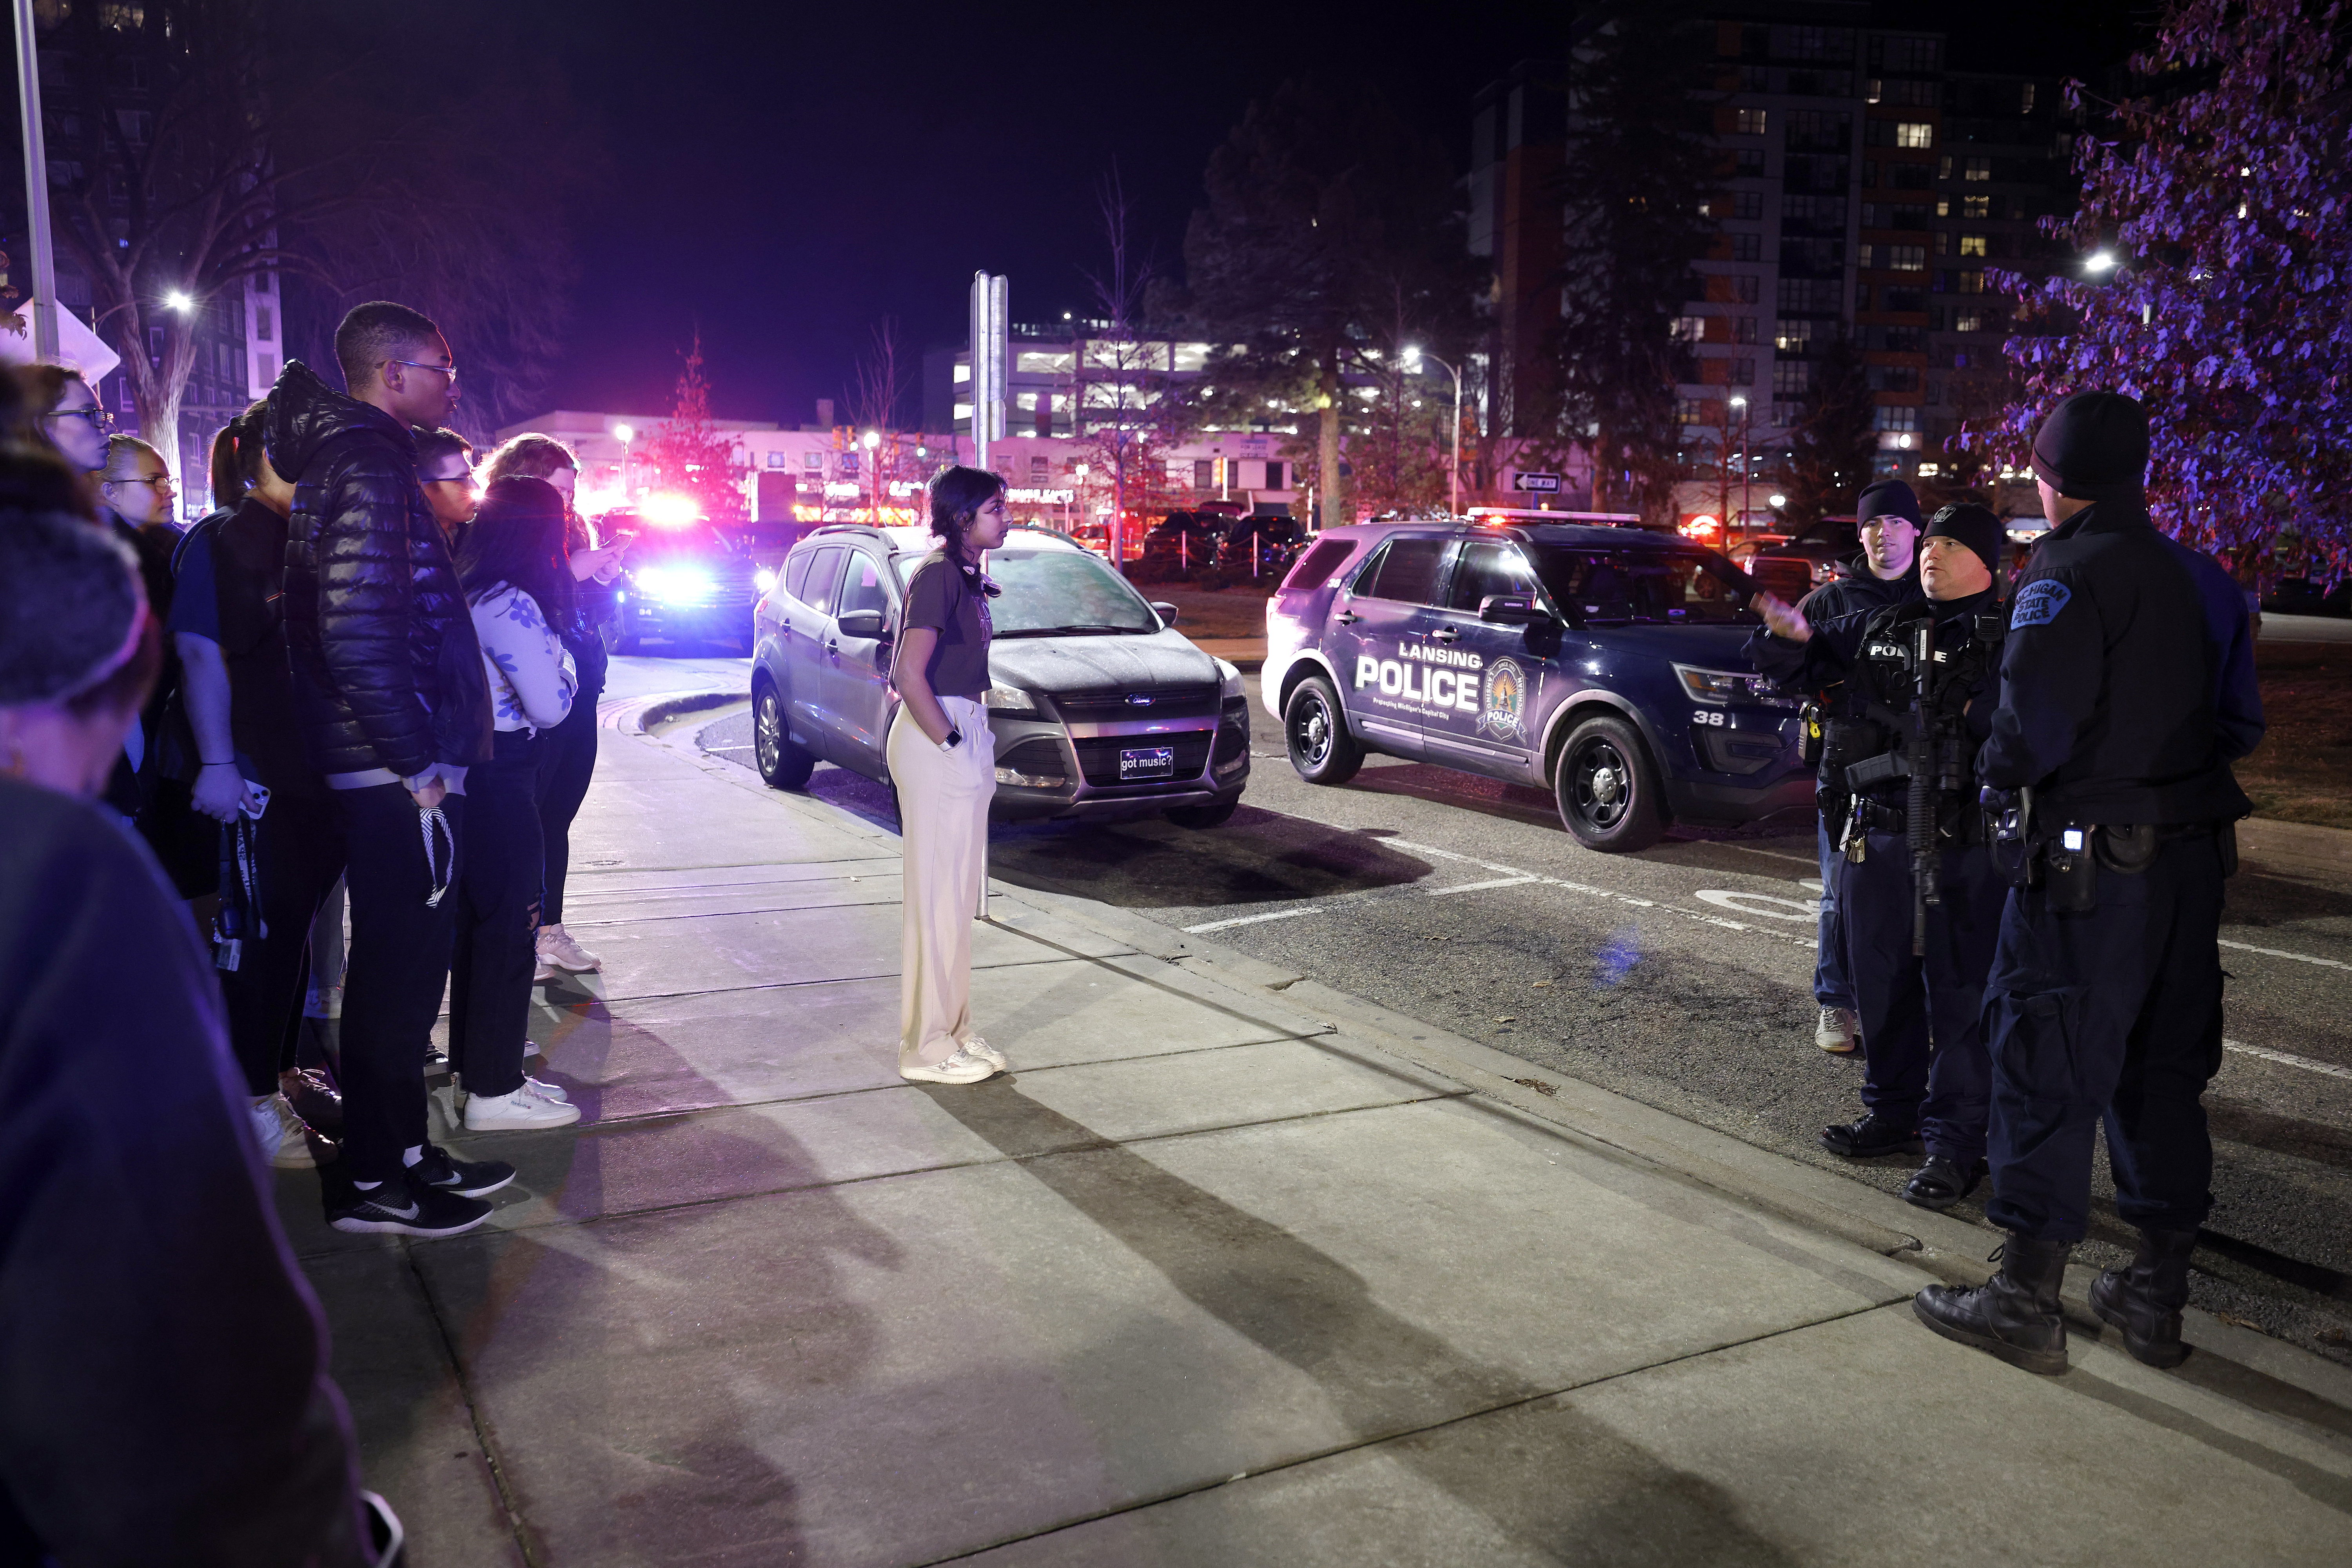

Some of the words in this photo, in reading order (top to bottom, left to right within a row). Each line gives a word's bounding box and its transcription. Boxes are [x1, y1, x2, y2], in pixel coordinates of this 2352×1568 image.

[1327, 578, 1342, 588] 38
[2018, 597, 2050, 612] STATE
[2013, 608, 2050, 624] POLICE
[1399, 642, 1481, 669] LANSING
[1870, 646, 1947, 663] POLE
[1355, 655, 1479, 712] POLICE
[1486, 672, 1494, 709] LANSING
[1373, 697, 1397, 710] Protecting
[1397, 702, 1421, 713] Michigan's
[1422, 708, 1439, 718] Capital
[1439, 711, 1450, 720] City
[1486, 711, 1519, 728] POLICE
[1693, 711, 1724, 726] 38
[1121, 757, 1137, 771] got
[1139, 755, 1172, 768] music?
